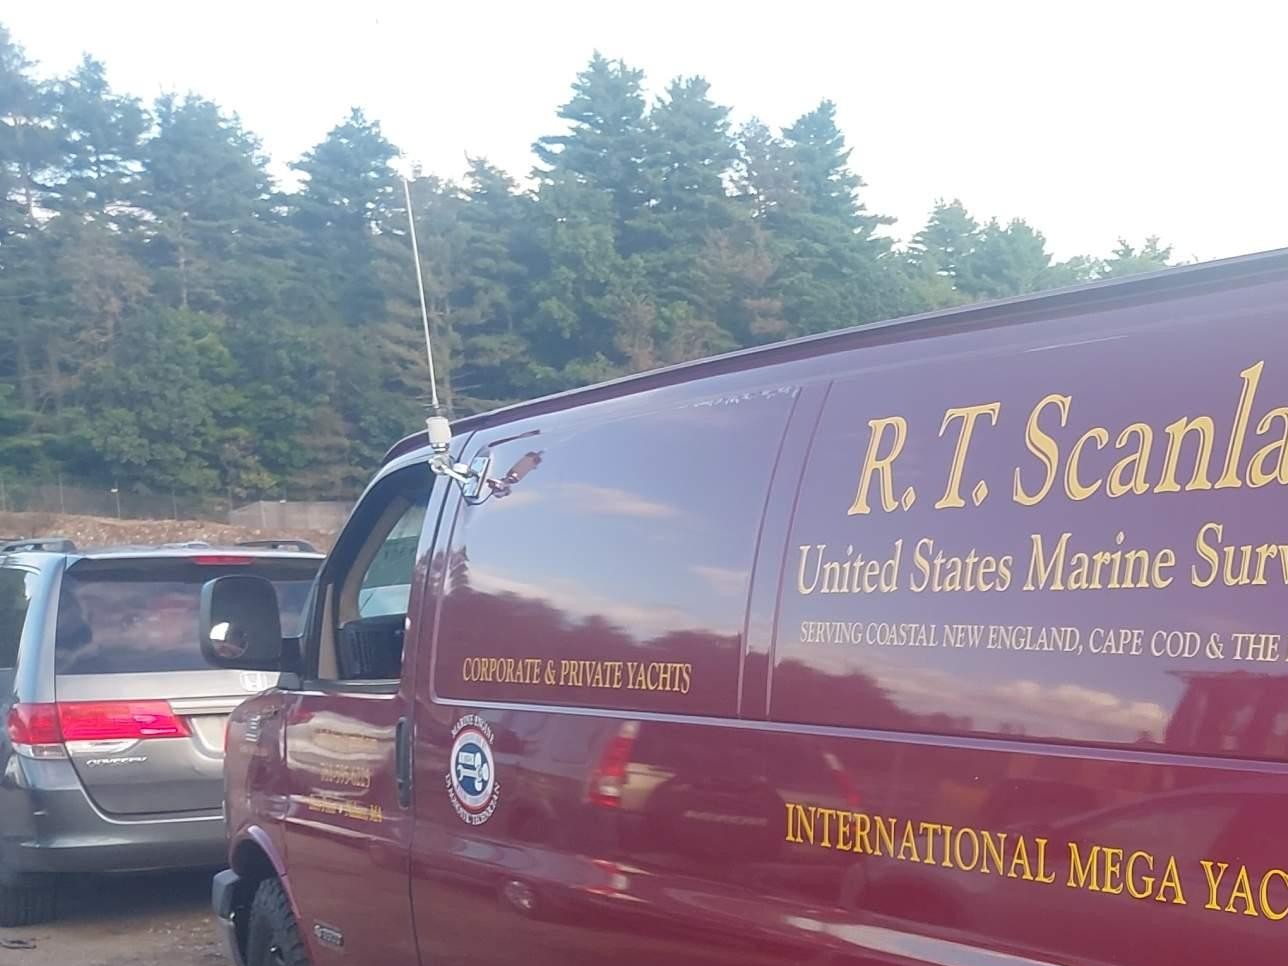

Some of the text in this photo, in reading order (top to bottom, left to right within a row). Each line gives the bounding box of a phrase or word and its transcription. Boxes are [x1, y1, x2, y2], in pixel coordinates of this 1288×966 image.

[848, 415, 917, 516] R.
[934, 402, 1001, 511] T.
[798, 538, 903, 595] United
[909, 538, 1013, 593] States
[1023, 531, 1176, 591] Marine
[800, 621, 863, 645] SERVING
[866, 622, 939, 648] COASTAL
[943, 624, 985, 649] NEW
[987, 625, 1083, 655] ENGLAND,
[1089, 628, 1144, 655] CAPE
[1150, 630, 1201, 658] COD
[1206, 633, 1225, 660] &
[1231, 633, 1280, 662] THE
[462, 657, 692, 694] CORPORATE & PRIVATE YACHTS
[784, 803, 1057, 884] INTERNATIONAL
[1067, 842, 1187, 905] MEGA
